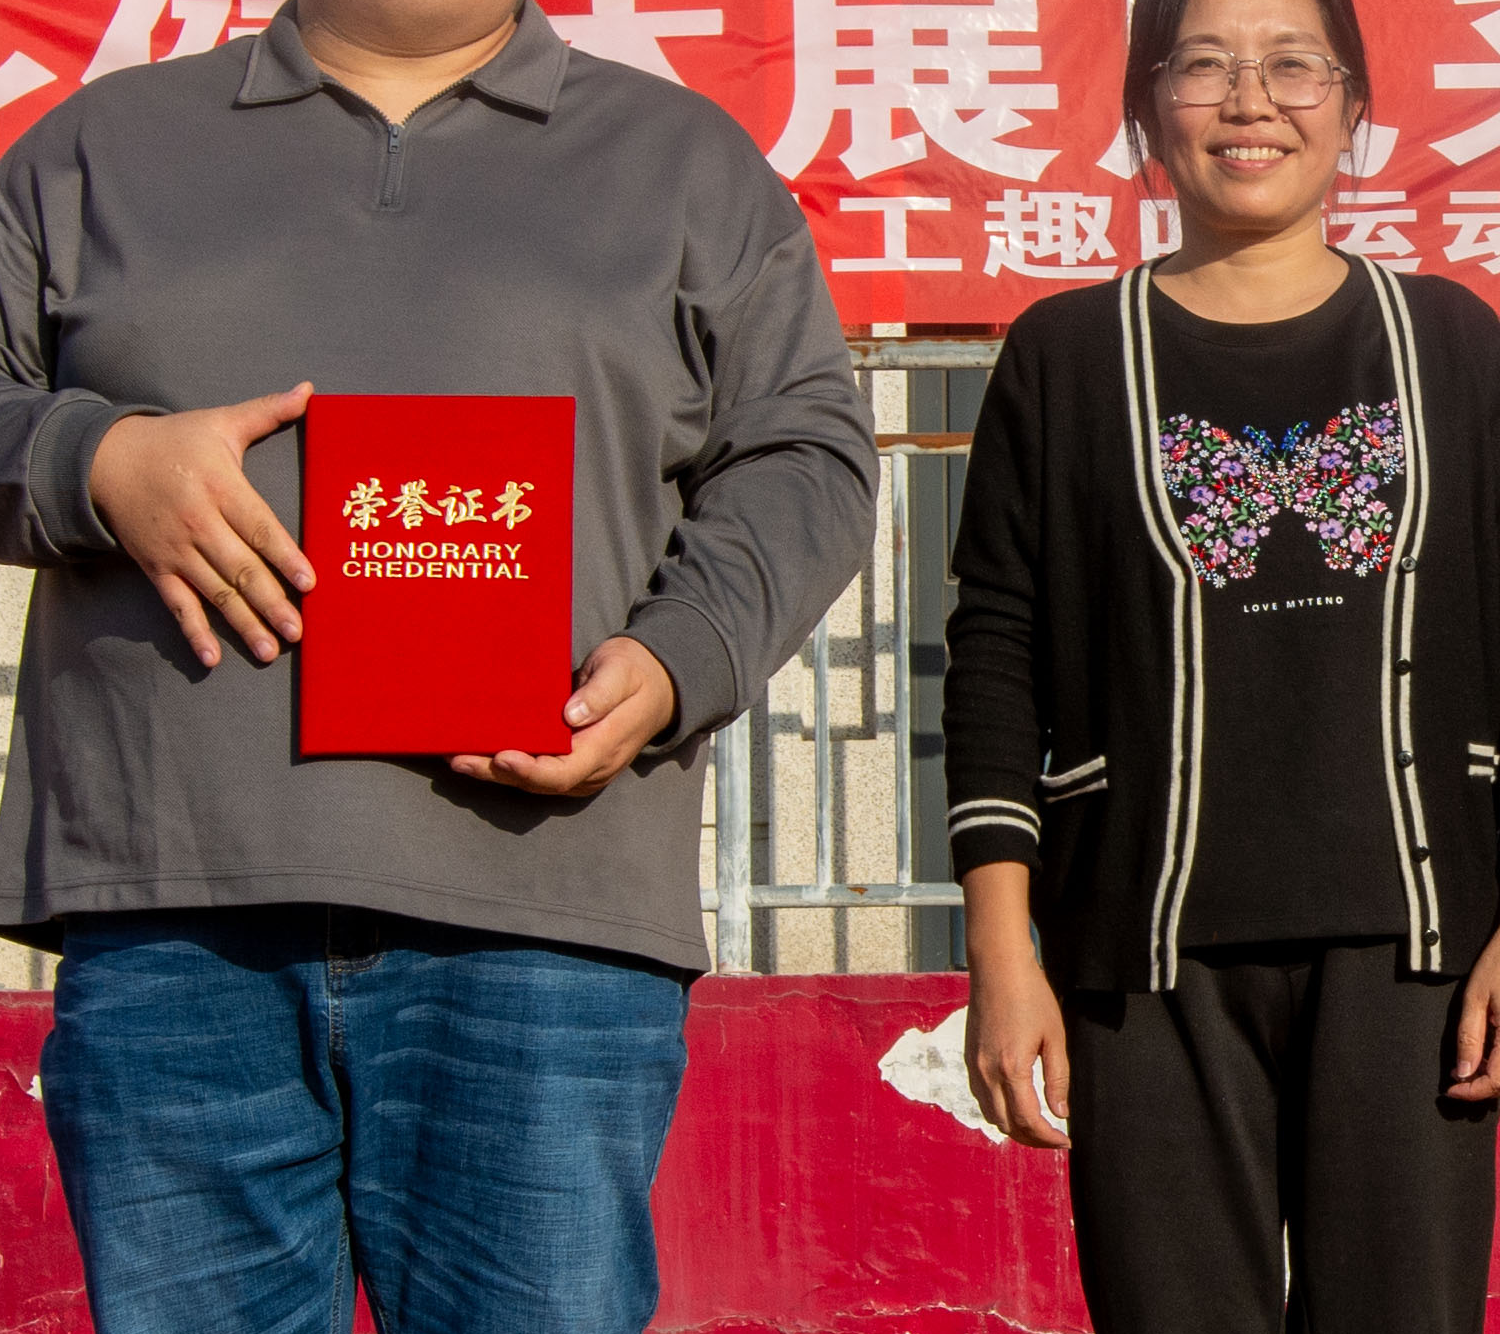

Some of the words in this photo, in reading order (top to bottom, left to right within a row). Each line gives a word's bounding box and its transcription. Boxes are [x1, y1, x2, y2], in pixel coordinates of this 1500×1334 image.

[342, 477, 535, 530] 荣誉证书
[349, 541, 522, 560] HONORARY
[342, 560, 530, 580] CREDENTIAL
[1243, 602, 1278, 613] LOVE
[1285, 595, 1344, 609] MYTENO
